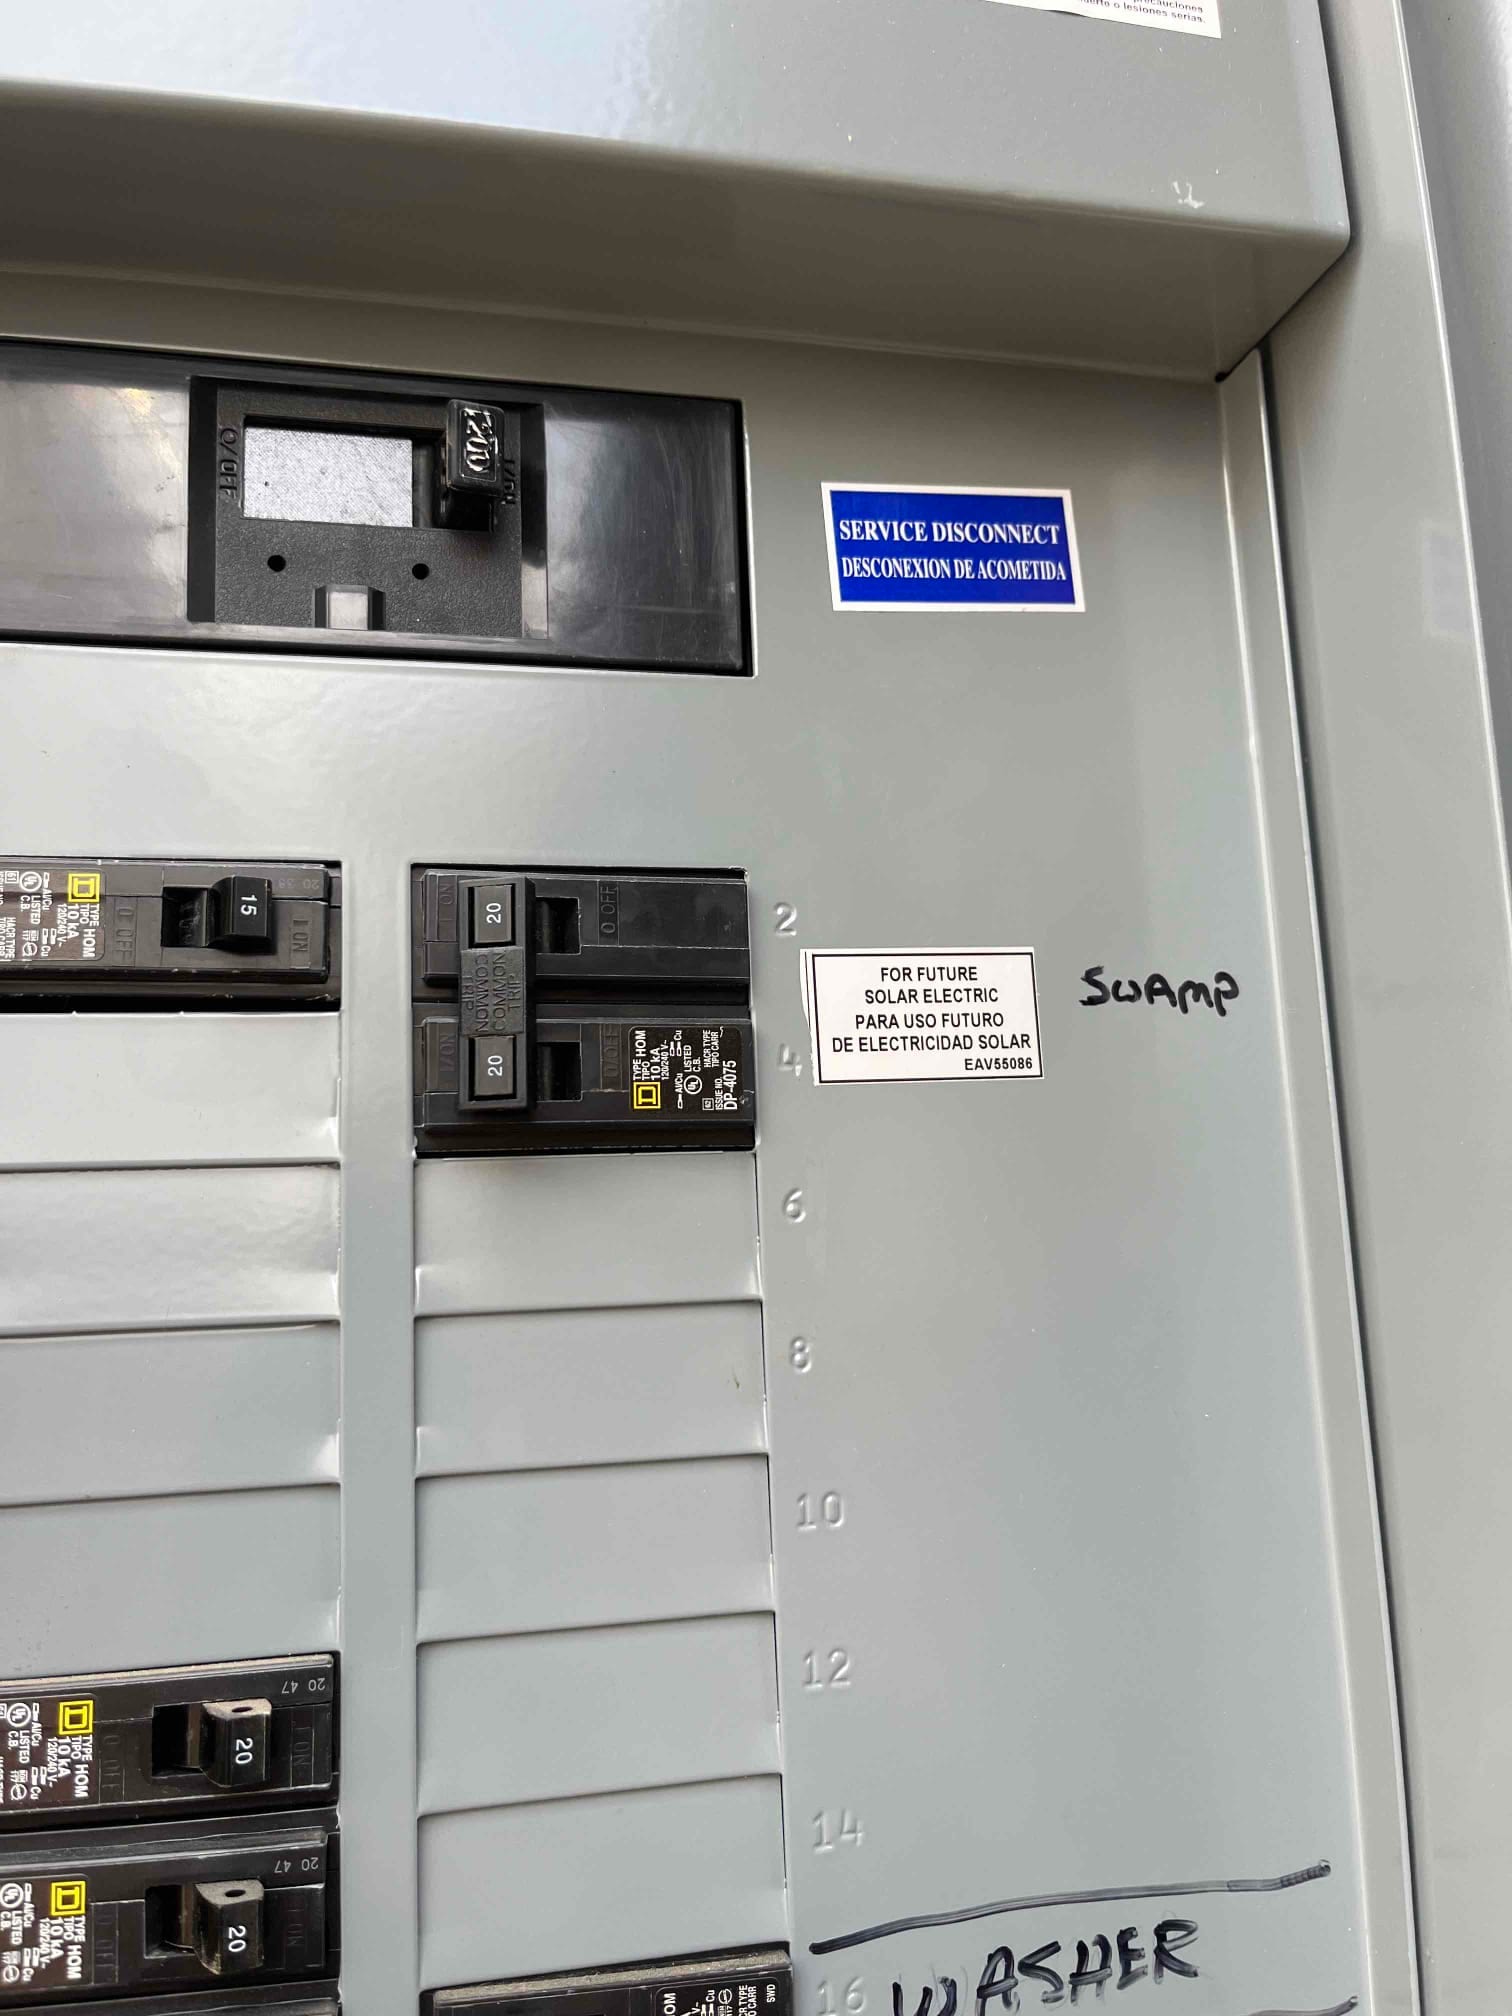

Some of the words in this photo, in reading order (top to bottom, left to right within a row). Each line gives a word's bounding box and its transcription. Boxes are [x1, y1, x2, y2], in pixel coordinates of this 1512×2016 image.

[1123, 2, 1168, 16] lesiones
[1171, 12, 1207, 23] serias.
[839, 520, 928, 542] SERVICE
[932, 522, 1060, 545] DISCONNECT
[842, 557, 951, 579] DESCONEXION
[954, 560, 975, 579] DE
[978, 560, 1067, 581] ACOMETIDA
[21, 895, 30, 912] C.B.
[31, 895, 41, 924] LISTED
[67, 904, 79, 920] 10
[80, 904, 90, 924] TIPO
[240, 895, 258, 916] 15
[486, 902, 502, 924] 20
[57, 904, 67, 934] 120/240
[90, 904, 100, 927] TYPE
[773, 902, 797, 936] 2
[5, 917, 16, 937] HACR
[67, 923, 79, 939] kA
[5, 939, 15, 958] TYPE
[41, 946, 51, 957] Cu
[82, 929, 96, 957] HOM
[880, 967, 913, 982] FOR
[917, 966, 978, 982] FUTURE
[462, 974, 474, 1011] TRIP
[475, 954, 489, 1033] COMMON
[492, 952, 506, 1032] COMMON
[507, 974, 521, 1012] TRIP
[864, 989, 919, 1004] SOLAR
[923, 988, 999, 1004] ELECTRIC
[856, 1014, 900, 1029] PARA
[903, 1014, 937, 1029] USO
[942, 1012, 1004, 1028] FUTURO
[635, 1030, 647, 1057] HOM
[673, 1030, 683, 1041] Cu
[702, 1029, 711, 1047] TYPE
[710, 1031, 719, 1050] CARR
[832, 1037, 854, 1053] DE
[859, 1035, 973, 1052] ELECTRICIDAD
[978, 1033, 1031, 1050] SOLAR
[487, 1055, 503, 1077] 20
[650, 1048, 661, 1063] kA
[661, 1051, 670, 1080] 120/240
[683, 1044, 692, 1073] LISTED
[693, 1057, 702, 1073] C.B.
[703, 1049, 712, 1068] HACR
[711, 1051, 720, 1068] TIPO
[964, 1057, 1033, 1071] EAV55086
[633, 1059, 642, 1081] TYPE
[642, 1061, 650, 1081] TIPO
[650, 1065, 661, 1081] 10
[714, 1077, 723, 1089] NO.
[722, 1060, 738, 1111] DP-4075
[715, 1089, 724, 1111] ISSUE
[782, 1188, 806, 1223] 6
[790, 1336, 812, 1374] 8
[796, 1491, 845, 1531] 10
[803, 1647, 851, 1689] 12
[281, 1679, 299, 1694] 47
[308, 1677, 326, 1692] 20
[8, 1730, 19, 1750] C.B.
[19, 1730, 30, 1763] LISTED
[58, 1736, 71, 1755] 10
[71, 1736, 82, 1759] TIPO
[81, 1734, 93, 1761] TYPE
[47, 1737, 59, 1773] 120/240
[235, 1738, 254, 1765] 20
[58, 1759, 71, 1778] kA
[74, 1764, 89, 1798] HOM
[31, 1786, 42, 1800] Cu
[812, 1808, 864, 1855] 14
[274, 1859, 292, 1874] 47
[301, 1856, 319, 1871] 20
[11, 1911, 22, 1945] LISTED
[40, 1917, 51, 1953] 120/240
[50, 1917, 64, 1936] 10
[63, 1916, 75, 1940] TIPO
[74, 1915, 86, 1942] TYPE
[50, 1939, 64, 1959] kA
[228, 1925, 247, 1953] 20
[67, 1945, 82, 1979] HOM
[893, 1920, 1199, 2016] WASHER
[22, 1967, 34, 1982] Cu
[664, 1992, 676, 2016] OM
[705, 1989, 715, 2002] Cu
[739, 1984, 748, 2006] TYPE
[748, 1986, 757, 2009] CARR
[766, 1984, 776, 2003] SWD
[817, 1977, 867, 2016] 16
